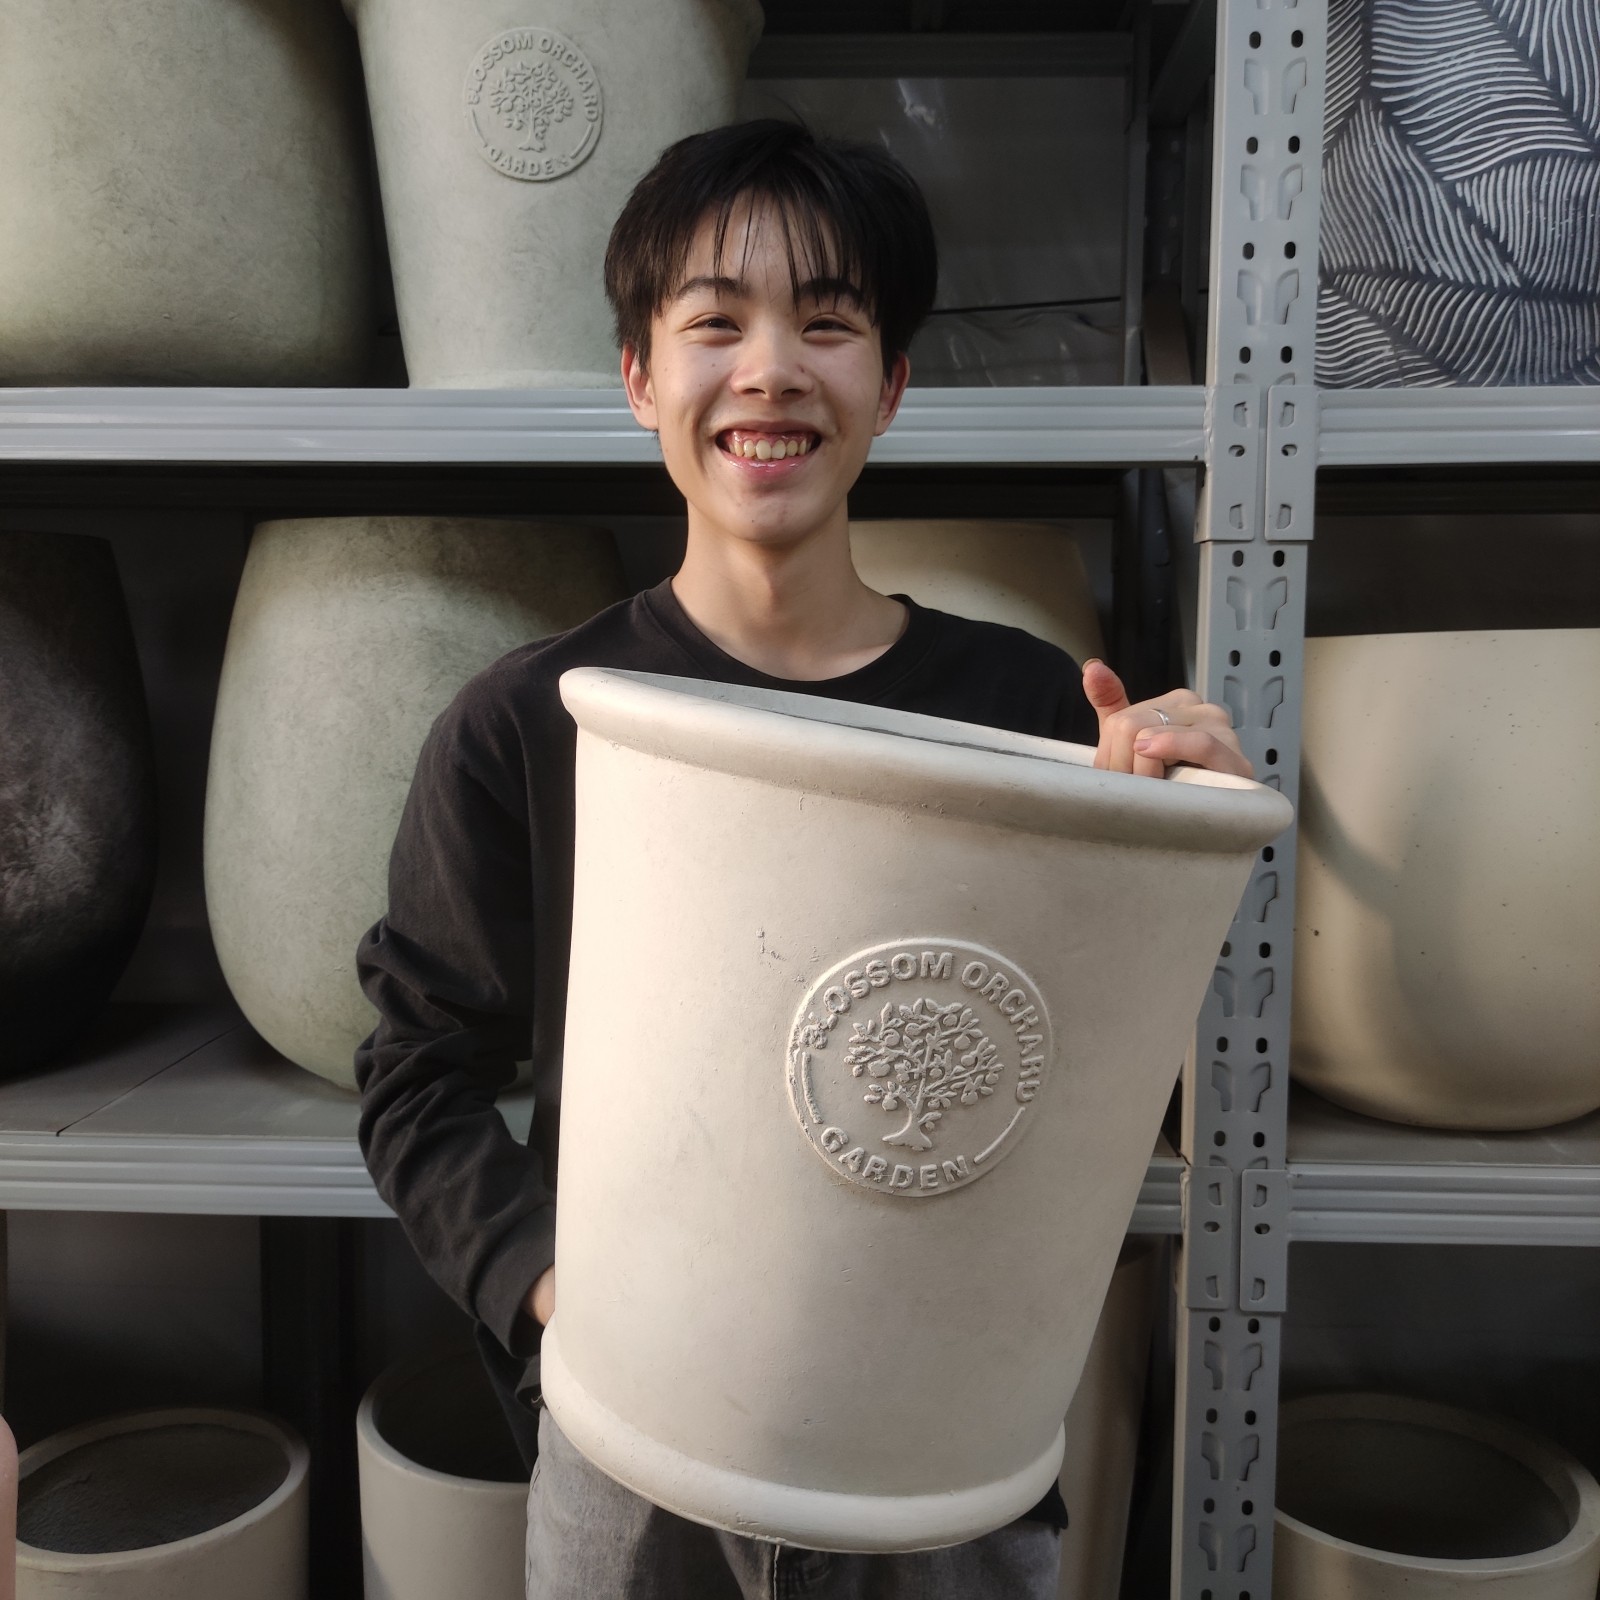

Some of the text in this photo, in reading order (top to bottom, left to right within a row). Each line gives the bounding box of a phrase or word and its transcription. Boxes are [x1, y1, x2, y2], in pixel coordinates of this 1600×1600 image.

[467, 32, 599, 122] BLOSSOM ORCHARD
[961, 961, 1045, 1103] ORCHARD
[820, 1126, 970, 1189] GARDEN
